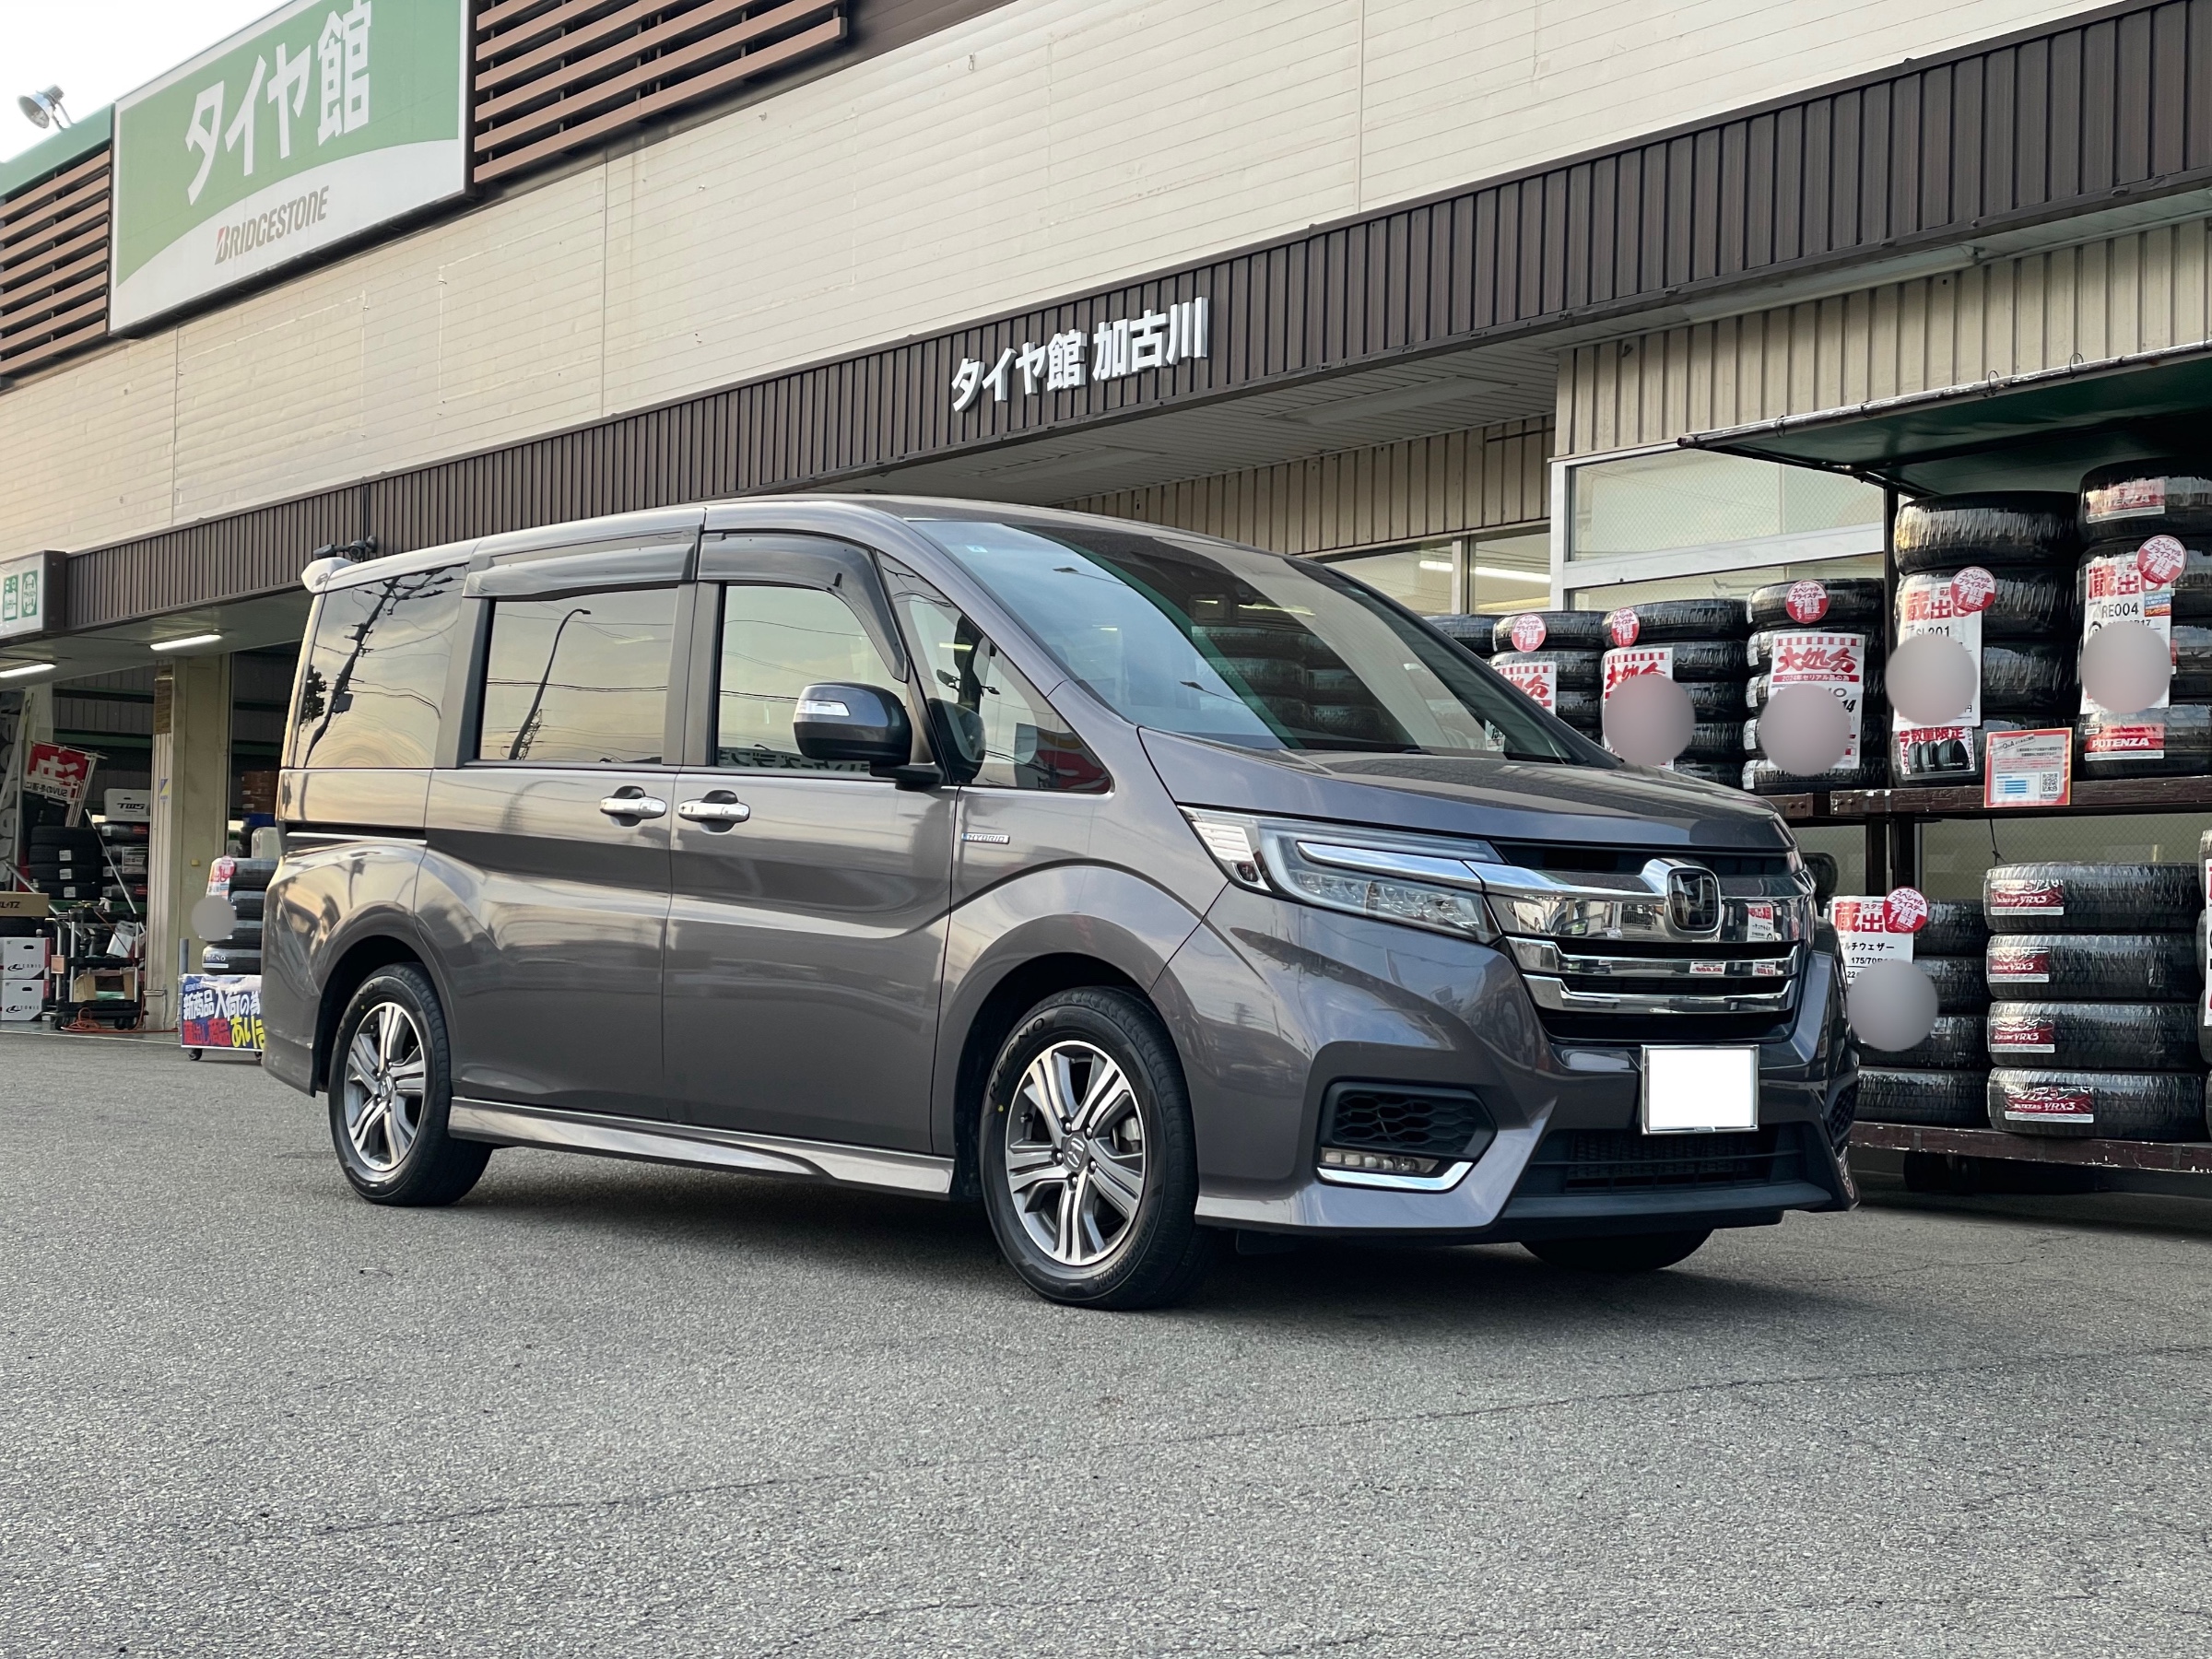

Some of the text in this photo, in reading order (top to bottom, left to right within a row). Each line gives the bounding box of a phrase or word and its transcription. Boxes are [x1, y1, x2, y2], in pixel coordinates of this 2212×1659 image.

[185, 0, 371, 206] タイヤ館
[215, 185, 329, 265] BRIDGESTONE
[951, 296, 1209, 412] タイヤ館 加古川
[2102, 603, 2138, 618] RE004
[2092, 738, 2149, 747] POTENZA
[989, 1018, 1044, 1100] REGNO
[2044, 1102, 2076, 1111] VRX3
